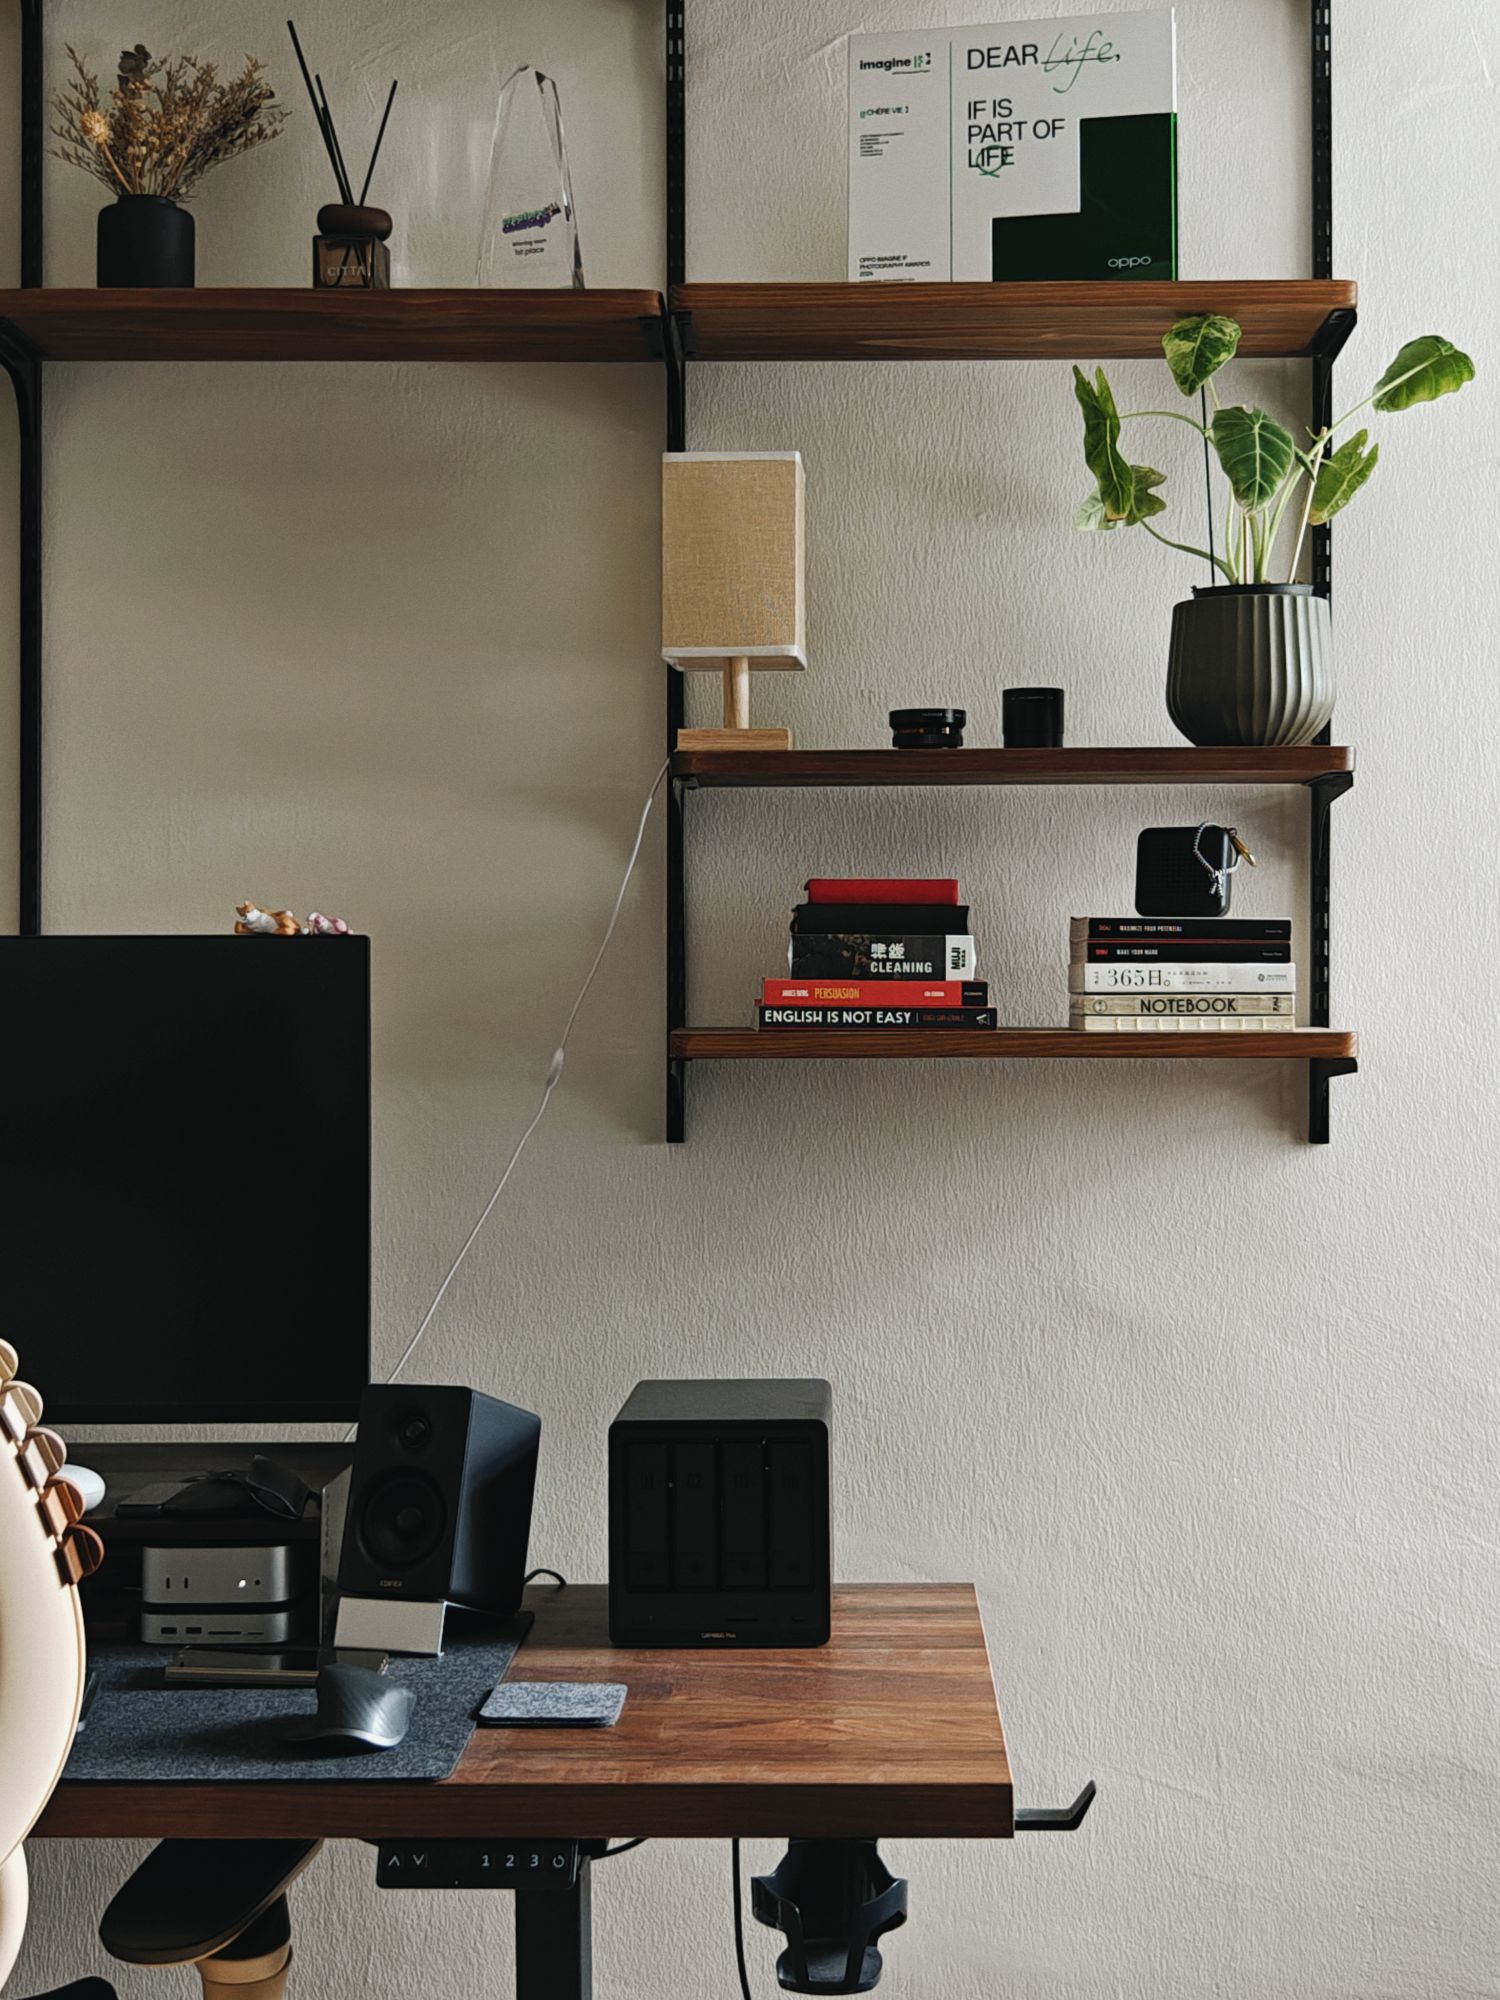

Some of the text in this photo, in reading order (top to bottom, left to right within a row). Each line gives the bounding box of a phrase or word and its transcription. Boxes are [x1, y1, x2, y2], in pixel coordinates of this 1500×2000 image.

[967, 43, 1039, 70] DEAR
[860, 58, 912, 72] imagine
[967, 98, 1013, 120] IF IS
[967, 118, 1066, 144] PART OF
[967, 146, 1015, 168] LIFE
[524, 247, 545, 256] place
[859, 262, 904, 270] PHOTOGRAPHY
[1107, 256, 1152, 269] oppo
[951, 947, 961, 970] MUJI
[870, 961, 933, 973] CLEANING
[814, 987, 860, 999] PERSUASION
[1140, 998, 1237, 1013] NOTEBOOK
[764, 1010, 823, 1023] ENGLISH
[827, 1010, 839, 1023] IS
[842, 1011, 872, 1023] NOT
[876, 1011, 912, 1023] EASY
[482, 1855, 539, 1866] 1 2 3
